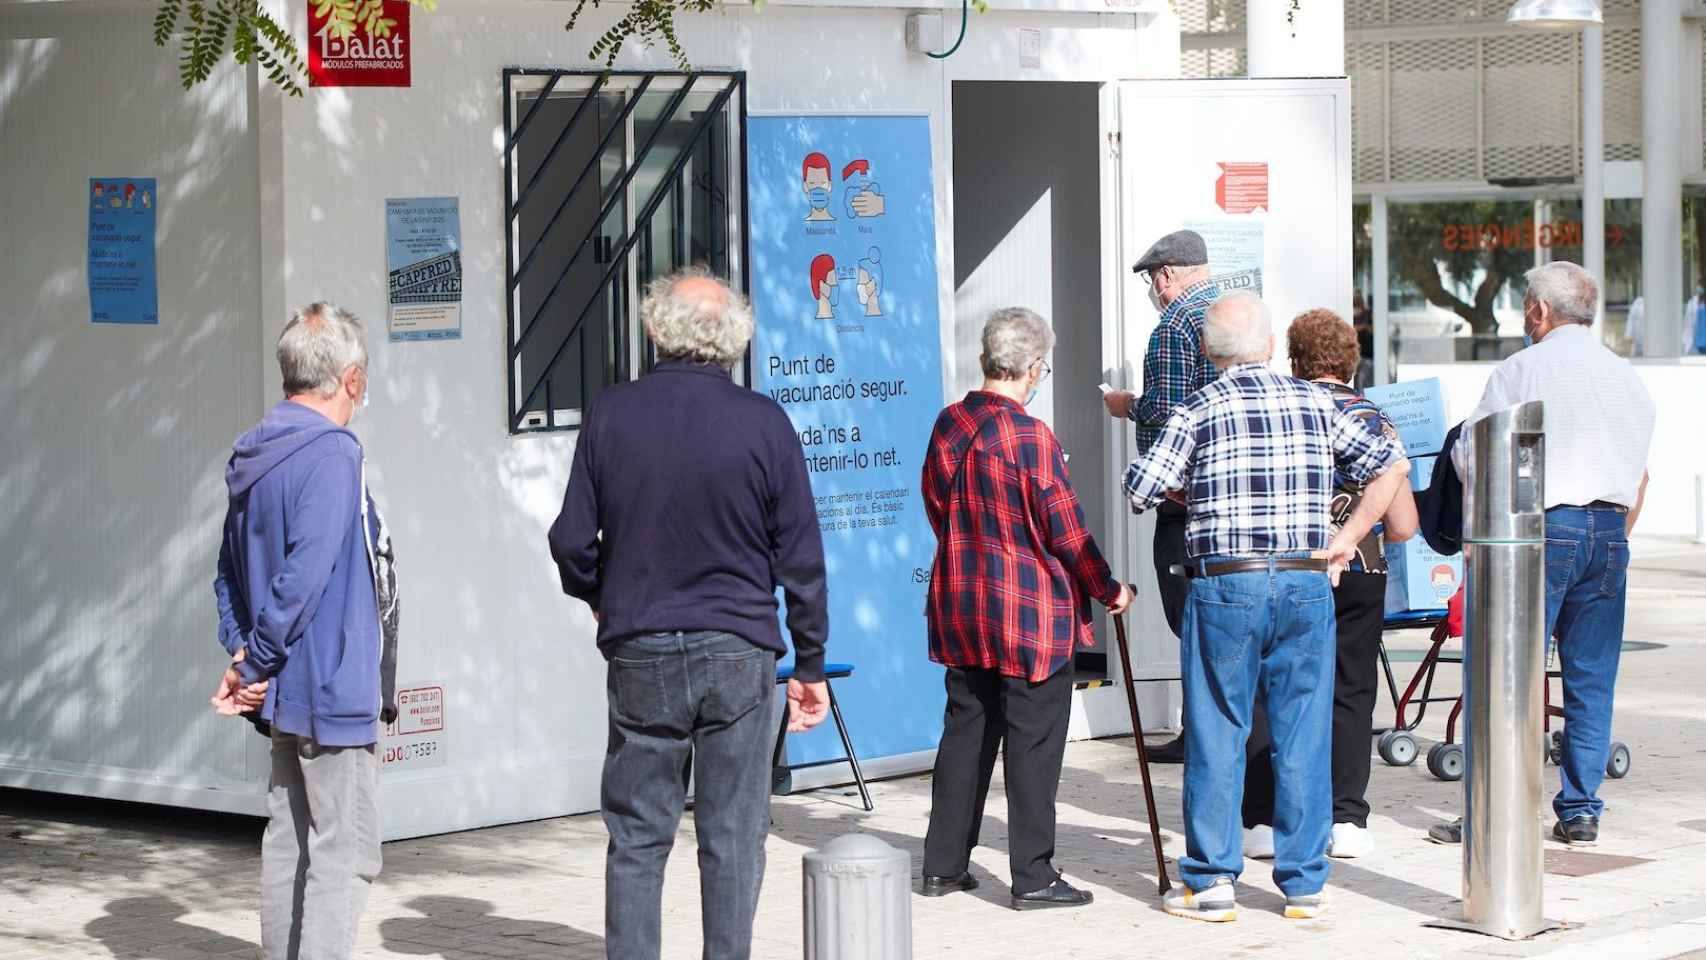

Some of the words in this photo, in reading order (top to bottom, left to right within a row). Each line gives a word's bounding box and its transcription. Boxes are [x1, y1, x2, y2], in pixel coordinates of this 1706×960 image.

[355, 60, 404, 69] PREFABRICADOS
[390, 258, 452, 289] #CAPFRED
[769, 356, 809, 377] Punt
[814, 354, 835, 374] de
[771, 377, 855, 404] vacunació
[860, 378, 908, 402] segur.
[798, 424, 847, 446] da'ns
[851, 426, 861, 442] a
[873, 448, 901, 468] net.
